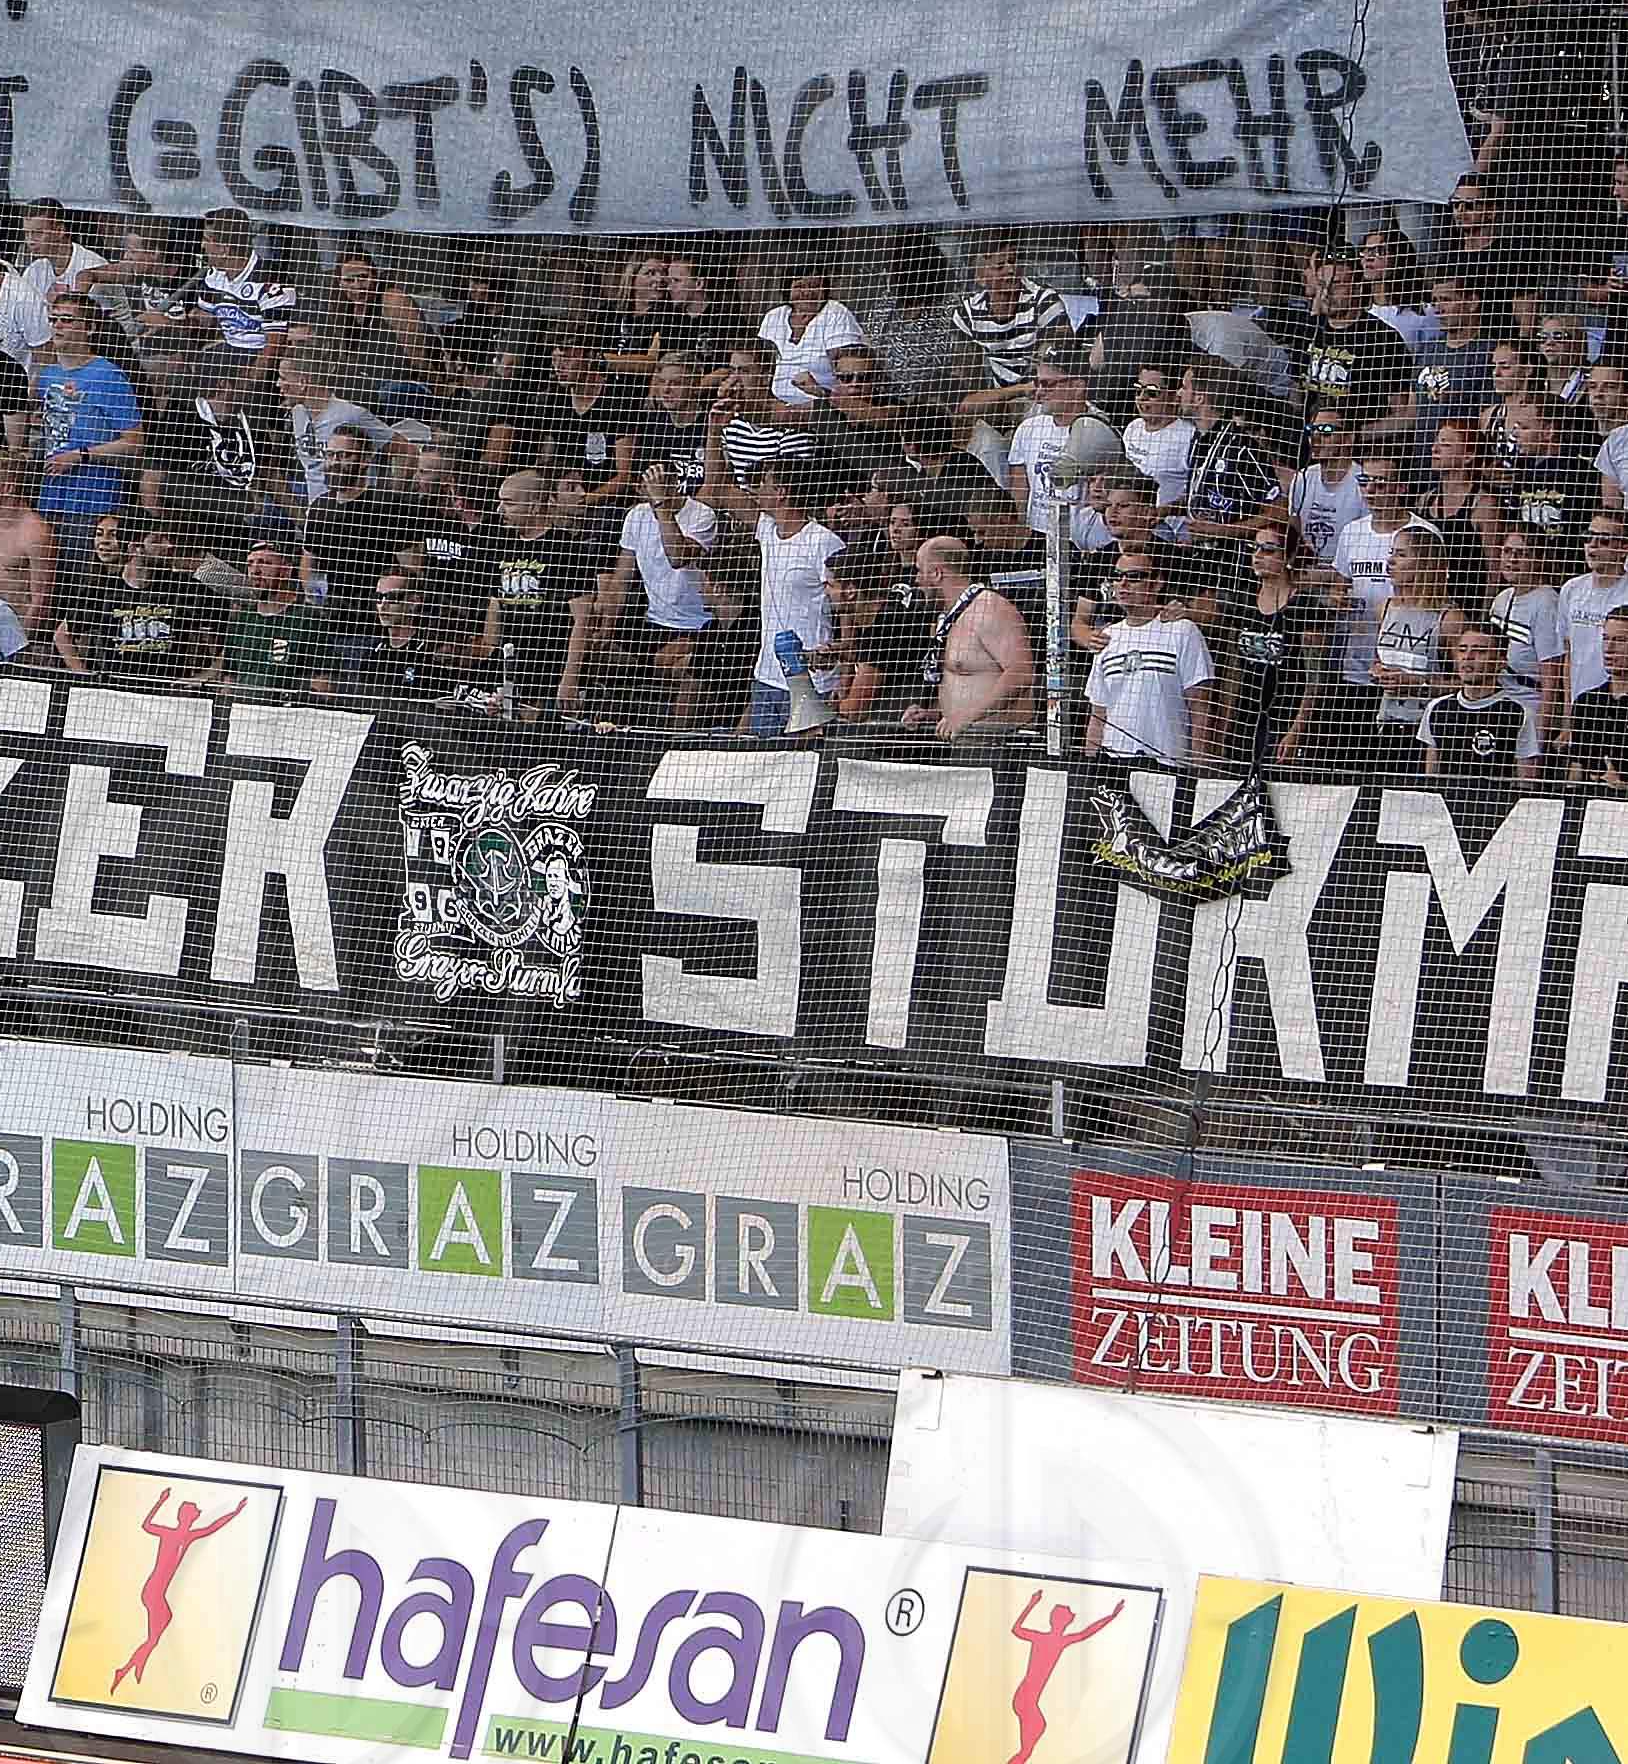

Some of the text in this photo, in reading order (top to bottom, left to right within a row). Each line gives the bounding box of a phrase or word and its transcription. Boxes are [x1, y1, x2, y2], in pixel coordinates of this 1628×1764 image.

[688, 65, 990, 220] NICHT
[1084, 49, 1384, 201] MEHR
[86, 1097, 229, 1143] HOLDING
[452, 1124, 599, 1169] HOLDING
[249, 1163, 580, 1271] GRAZ
[843, 1165, 991, 1210] HOLDING
[630, 1202, 972, 1318] GRAZ
[1090, 1195, 1383, 1306] KLEINE
[1089, 1305, 1385, 1394] ZEITUNG
[279, 1498, 864, 1757] hafesan
